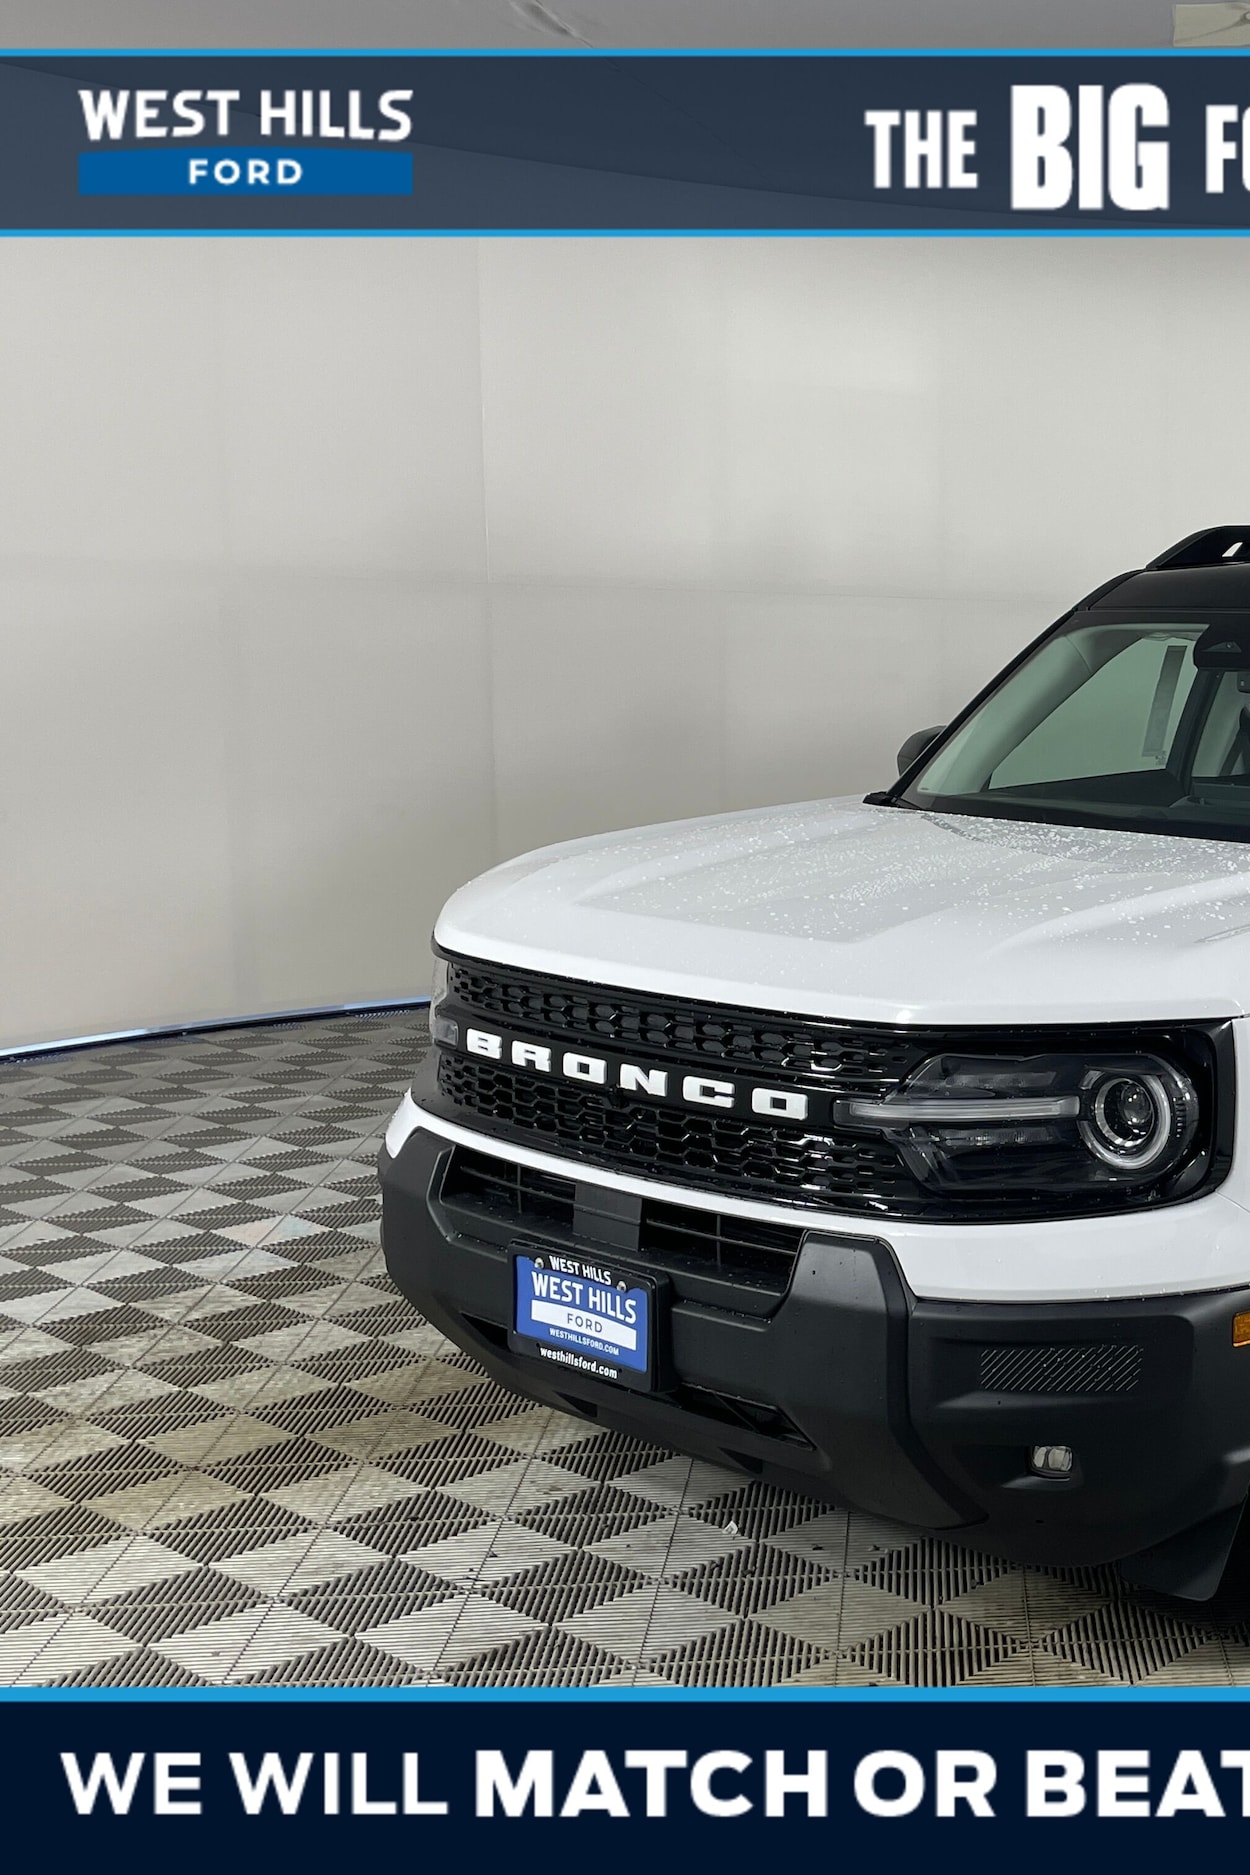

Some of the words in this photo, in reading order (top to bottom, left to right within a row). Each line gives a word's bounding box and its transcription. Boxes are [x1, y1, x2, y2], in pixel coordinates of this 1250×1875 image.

[466, 1028, 808, 1120] BRONCO
[549, 1255, 580, 1275] WEST
[582, 1264, 612, 1286] HILLS
[531, 1271, 584, 1305] WEST
[588, 1287, 637, 1325] HILLS
[567, 1313, 603, 1333] FORD
[549, 1327, 620, 1356] WESTHILLSFORD.COM
[540, 1347, 618, 1379] westhillsford.com
